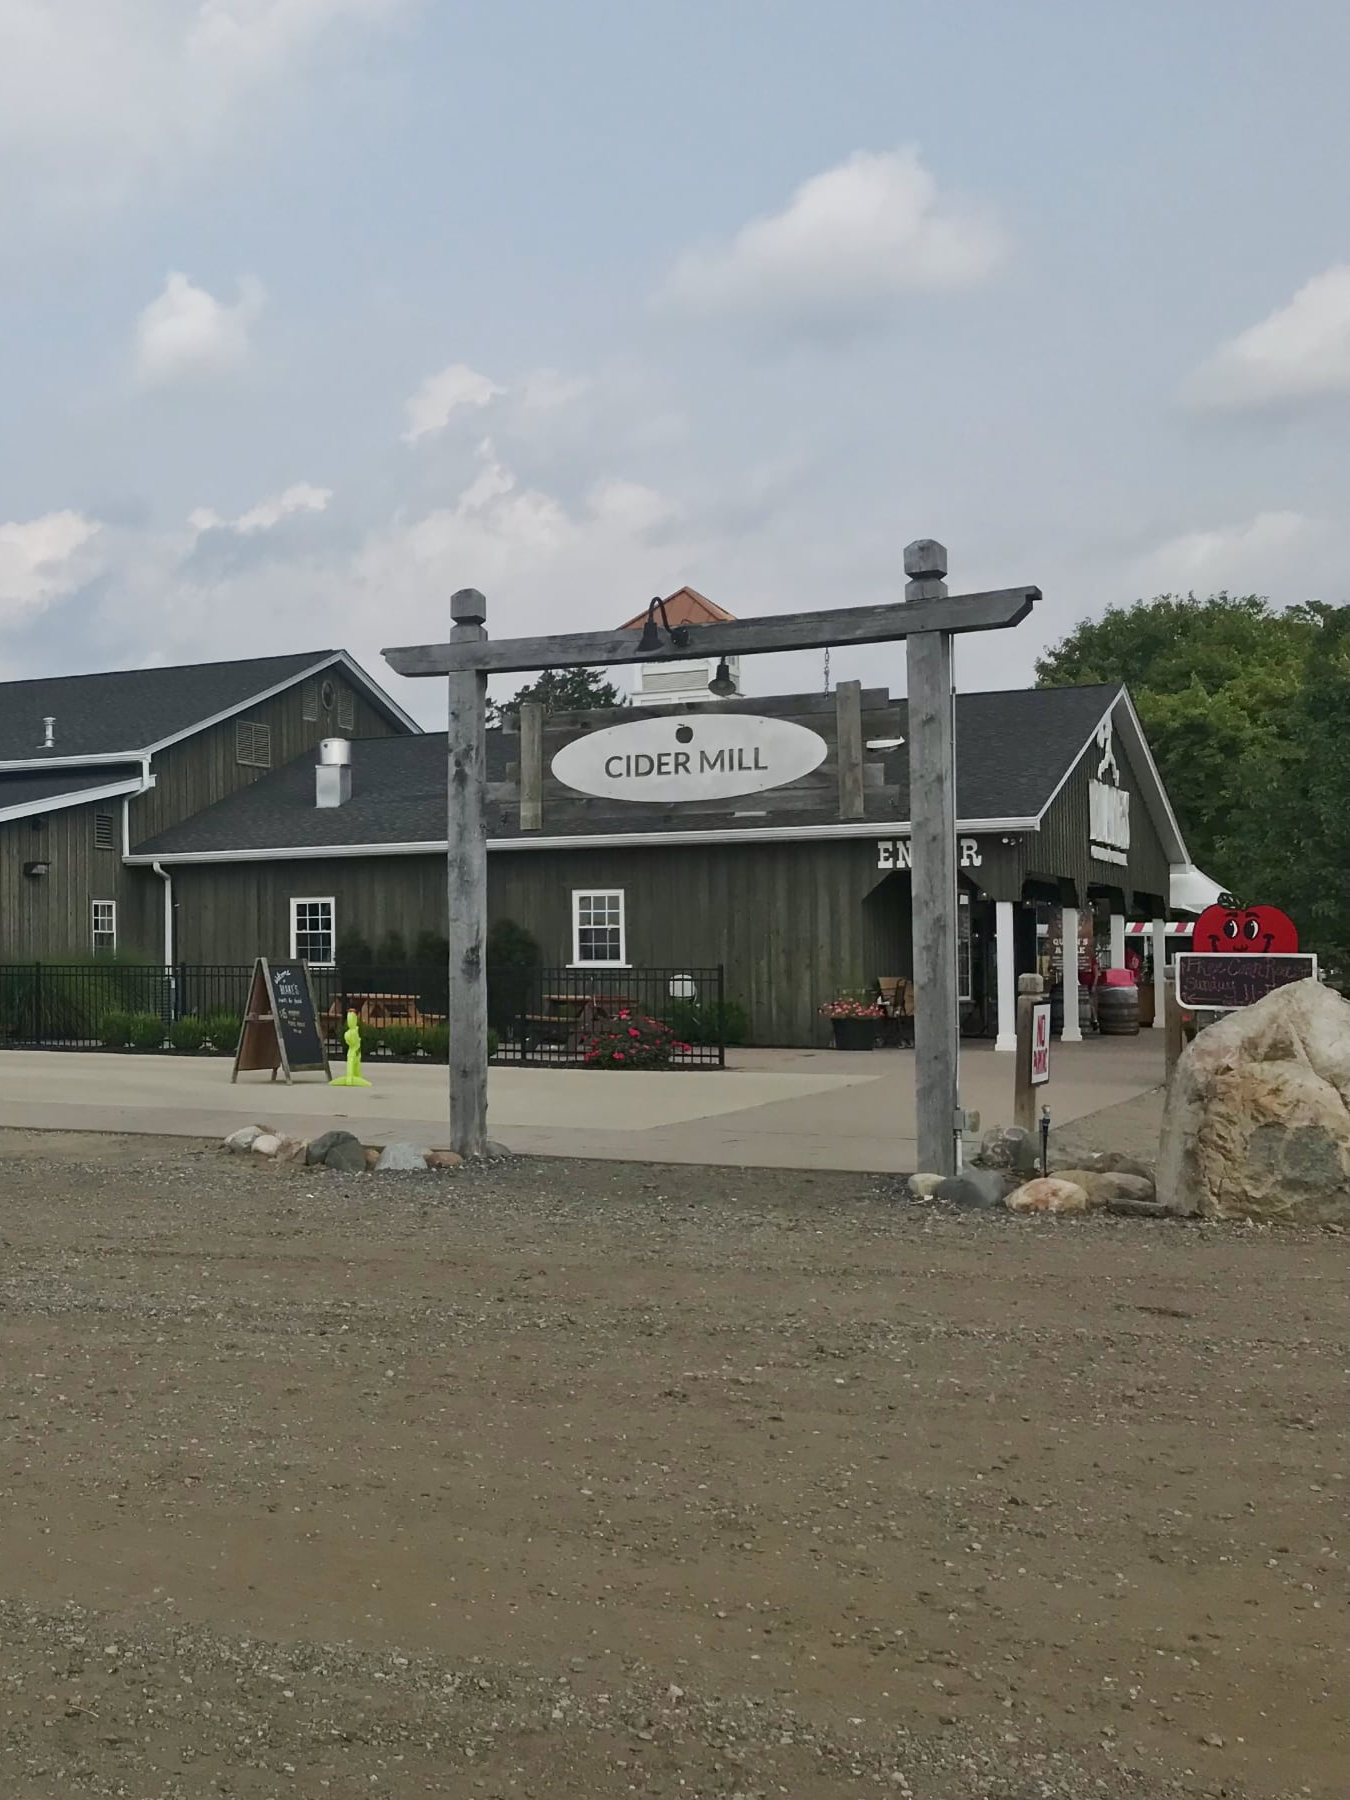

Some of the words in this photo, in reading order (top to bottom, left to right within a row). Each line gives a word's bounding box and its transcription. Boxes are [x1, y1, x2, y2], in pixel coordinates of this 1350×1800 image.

[604, 752, 691, 779] CIDER
[699, 747, 769, 774] MILL
[877, 838, 983, 869] ENR
